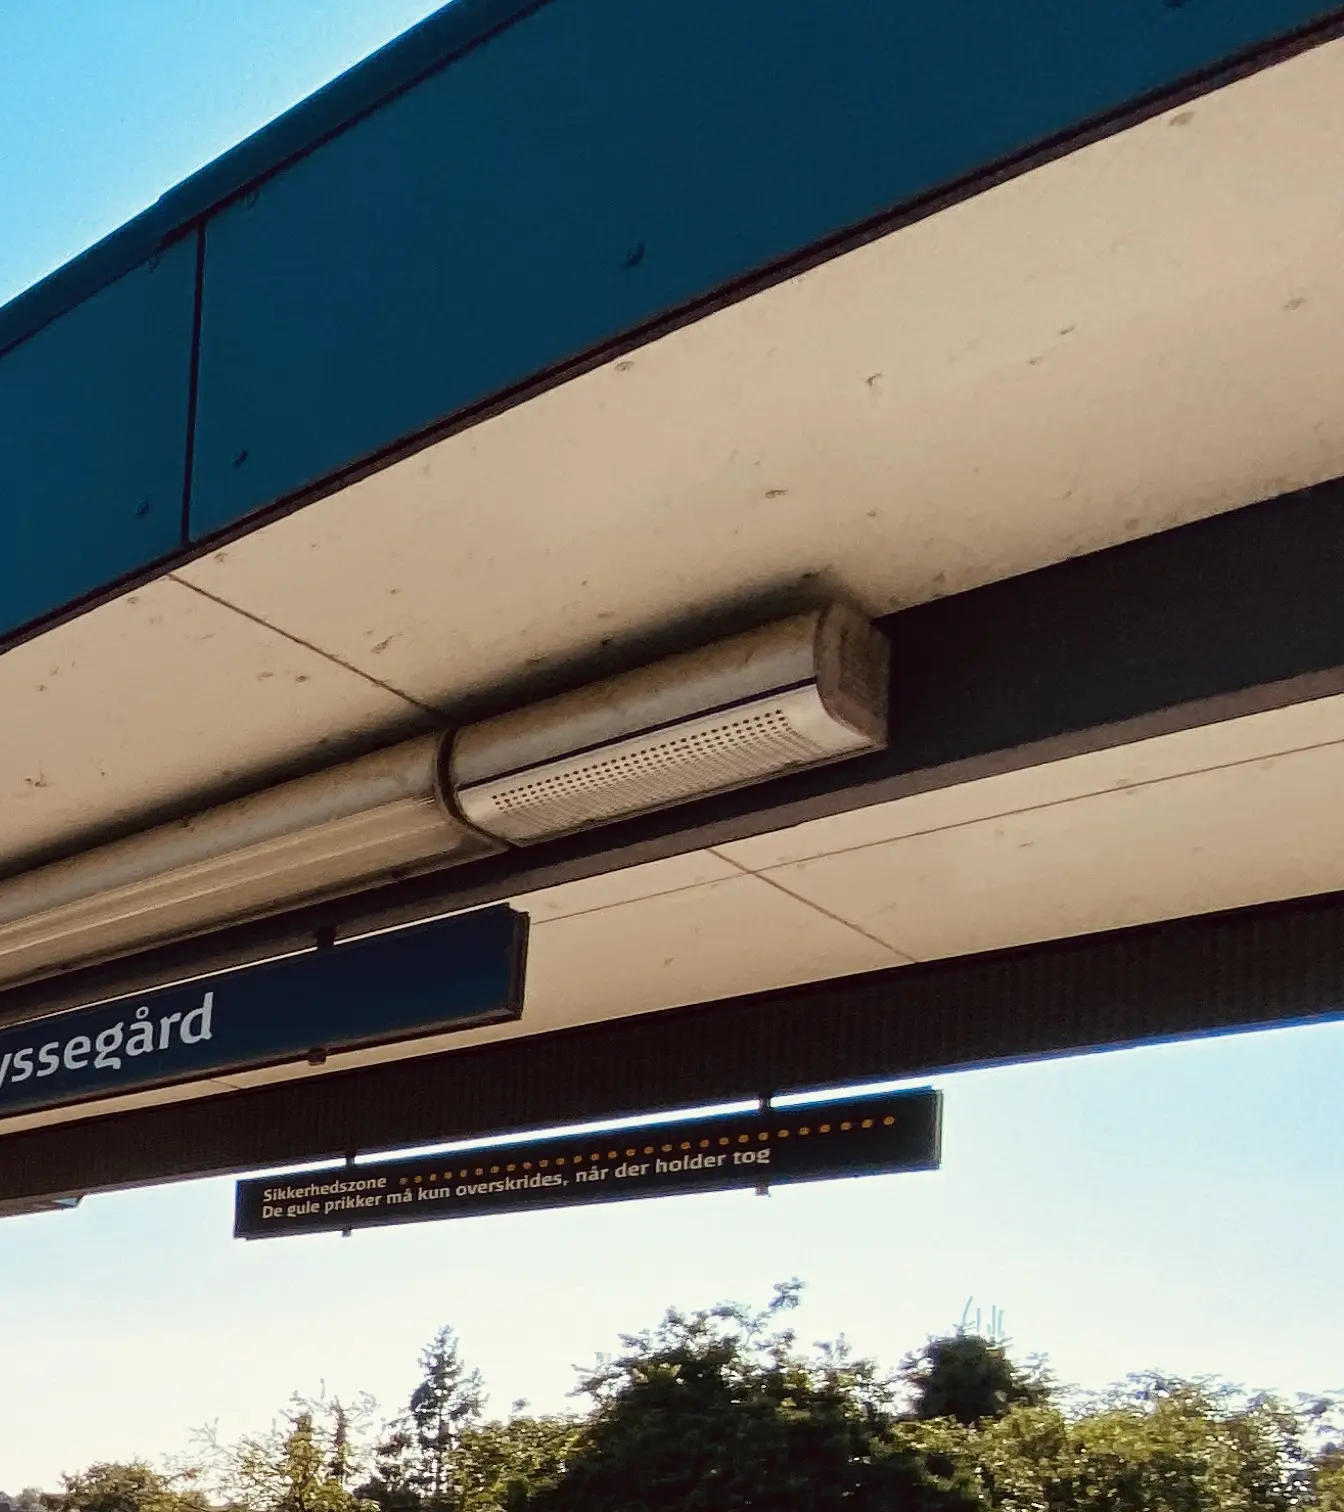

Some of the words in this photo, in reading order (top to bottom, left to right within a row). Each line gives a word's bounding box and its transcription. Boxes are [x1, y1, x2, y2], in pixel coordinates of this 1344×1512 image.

[262, 1205, 283, 1219] De
[286, 1201, 321, 1218] gule
[324, 1195, 382, 1215] prikker
[386, 1187, 413, 1204] må
[418, 1185, 450, 1202] kun
[455, 1172, 569, 1197] overskrides,
[575, 1164, 609, 1184] når
[615, 1161, 650, 1179] der
[655, 1152, 726, 1175] holder
[733, 1147, 772, 1166] tog
[262, 1176, 387, 1202] Sikkerhedszone
